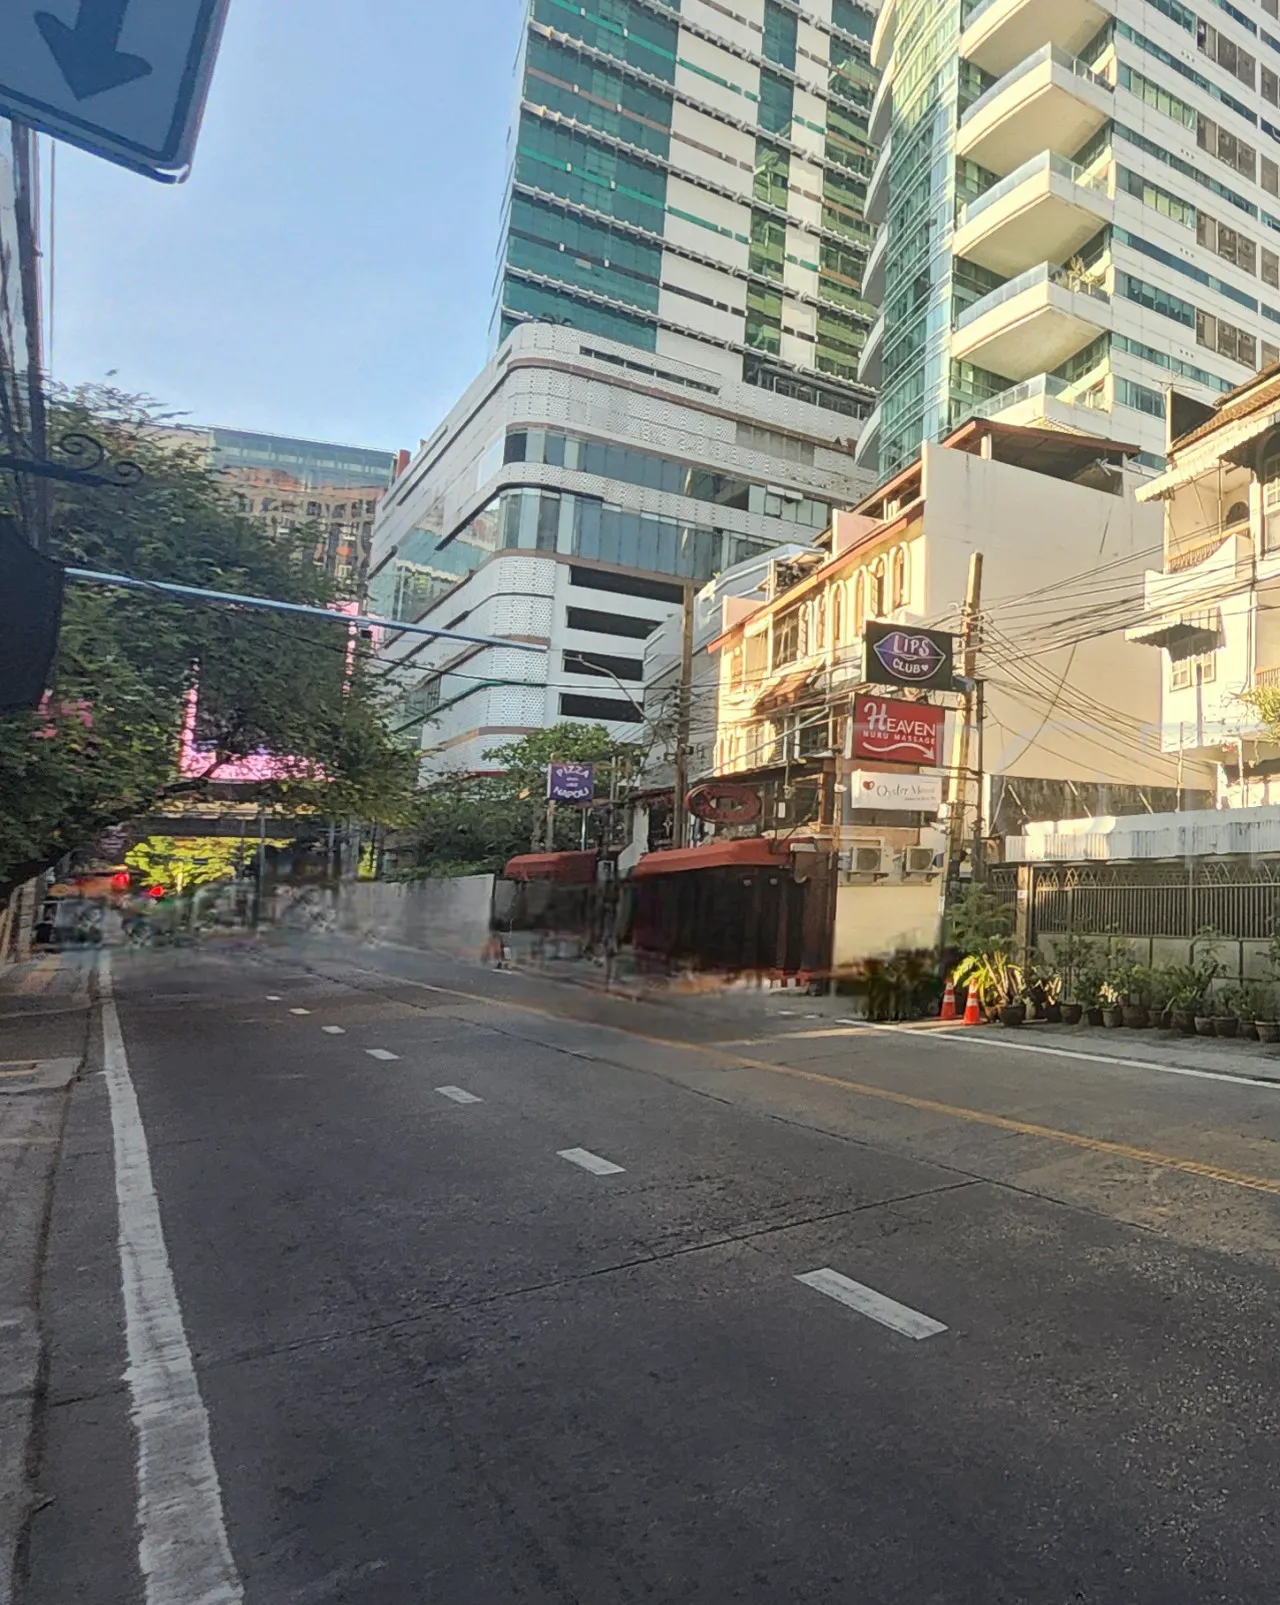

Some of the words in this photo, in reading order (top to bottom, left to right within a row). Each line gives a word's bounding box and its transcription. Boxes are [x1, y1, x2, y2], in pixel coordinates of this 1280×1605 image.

[893, 635, 929, 657] LIPS
[893, 657, 921, 674] CLUB
[863, 702, 936, 737] HEAVEN
[863, 730, 889, 740] NURU
[894, 734, 935, 745] MASSAGE
[555, 765, 590, 779] PIZZA
